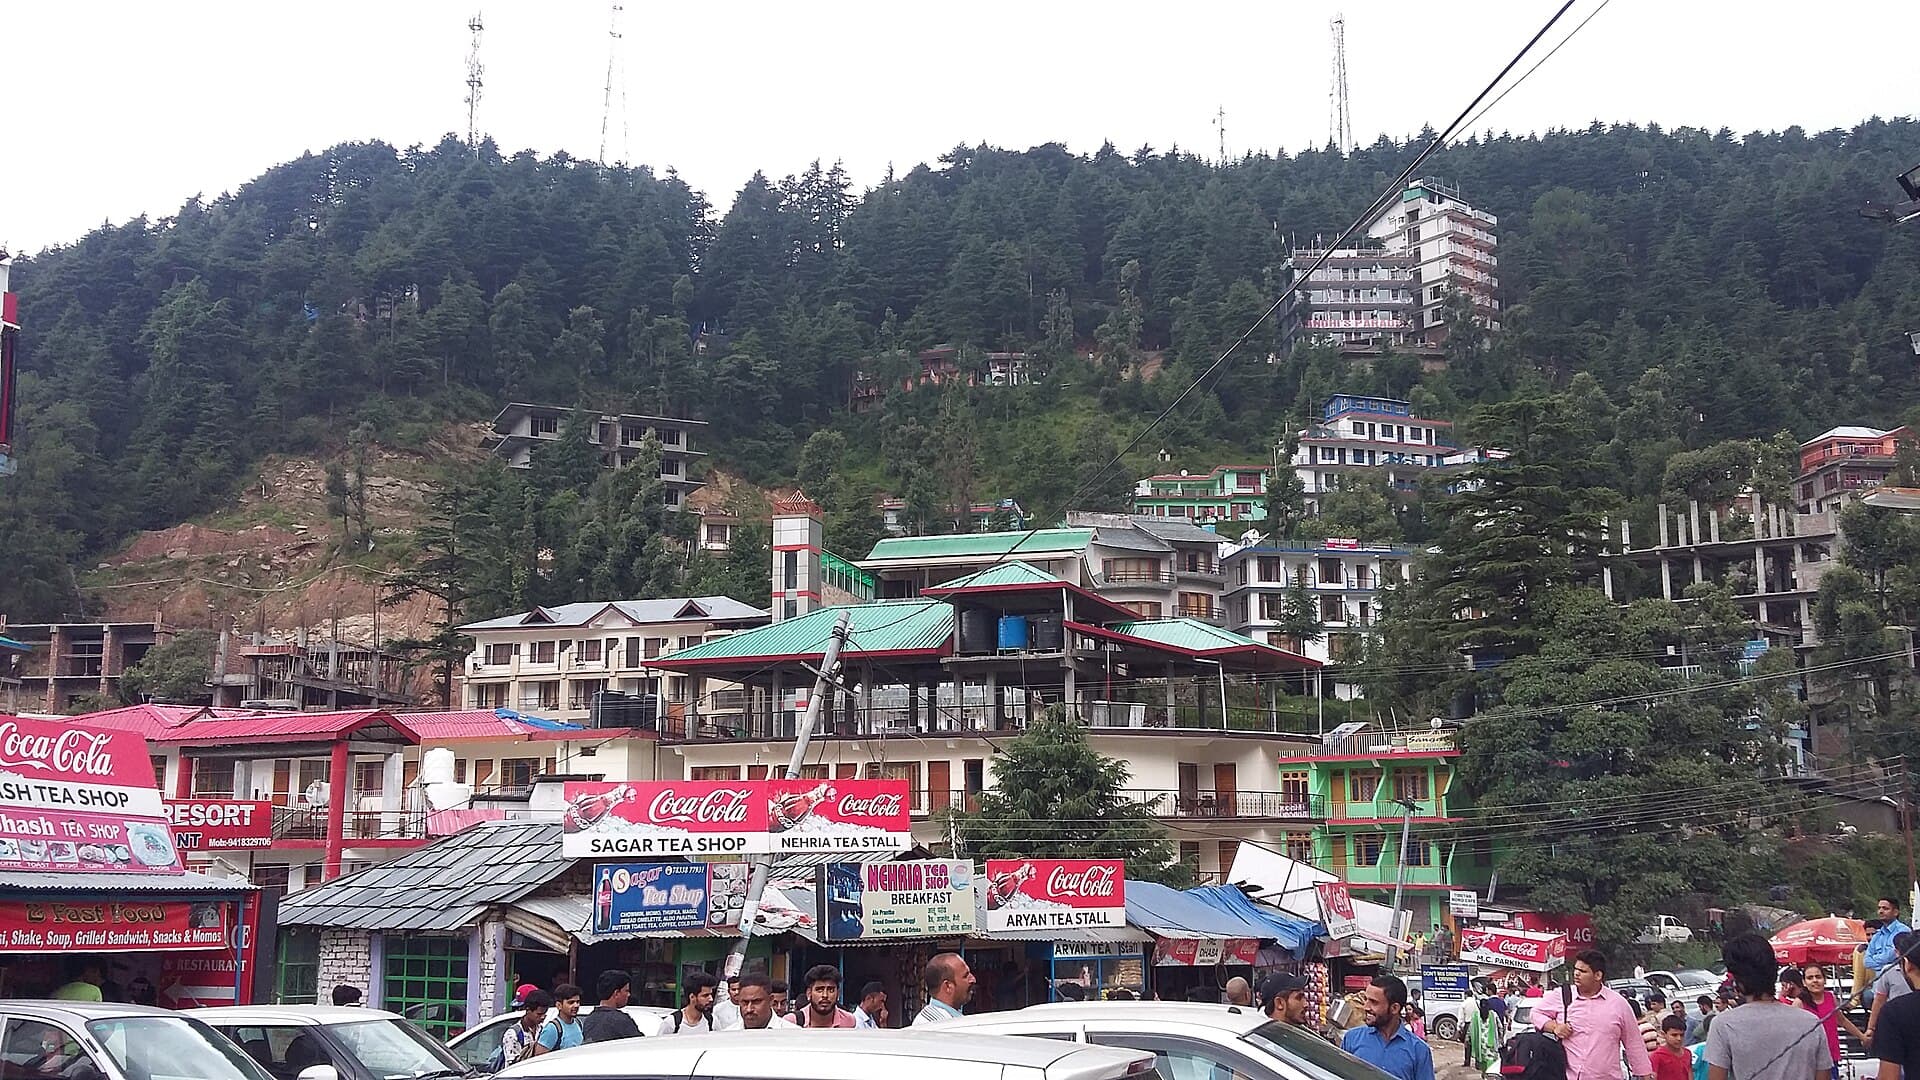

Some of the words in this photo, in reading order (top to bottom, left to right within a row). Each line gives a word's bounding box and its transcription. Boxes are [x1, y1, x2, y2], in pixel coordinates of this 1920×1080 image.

[0, 721, 113, 776] Coca-Cola
[33, 785, 73, 805] TEA
[78, 788, 129, 808] SHOP
[837, 793, 903, 817] Coca-Cola
[161, 804, 255, 826] RESORT
[648, 789, 752, 823] Coca-Cola
[0, 813, 56, 836] hash
[60, 821, 85, 837] TEA
[89, 823, 119, 839] SHOP
[590, 838, 653, 852] SAGAR
[657, 838, 693, 851] TEA
[697, 837, 746, 851] SHOP
[782, 837, 831, 848] NEHRIA
[834, 837, 859, 847] TEA
[862, 836, 900, 847] STALL
[867, 863, 923, 892] NEHRIA
[924, 864, 948, 876] TEA
[612, 866, 662, 893] Sagar
[925, 876, 949, 889] SHOP
[1046, 866, 1117, 897] Coca-Cola
[643, 886, 668, 906] Tea
[669, 885, 704, 908] Shop
[891, 892, 952, 905] BREAKFAST
[50, 904, 104, 923] Fast
[110, 904, 166, 923] Food
[1006, 914, 1047, 927] ARYAN
[1050, 913, 1073, 925] TEA
[1076, 912, 1111, 925] STALL
[11, 930, 44, 948] Shake,
[46, 931, 73, 949] Soup,
[75, 930, 106, 945] Grilled
[107, 930, 151, 947] Sandwich,
[152, 930, 181, 944] Snacks
[183, 930, 191, 943] &
[192, 930, 222, 943] Momos
[1573, 928, 1592, 942] 4G
[1055, 943, 1087, 955] ARYAN
[1091, 943, 1111, 954] TEA
[1120, 943, 1138, 954] Stall
[1200, 948, 1219, 957] DHABA
[1499, 940, 1539, 957] Coca-Cola
[1476, 955, 1493, 963] M.C.
[1494, 957, 1529, 968] PARKING
